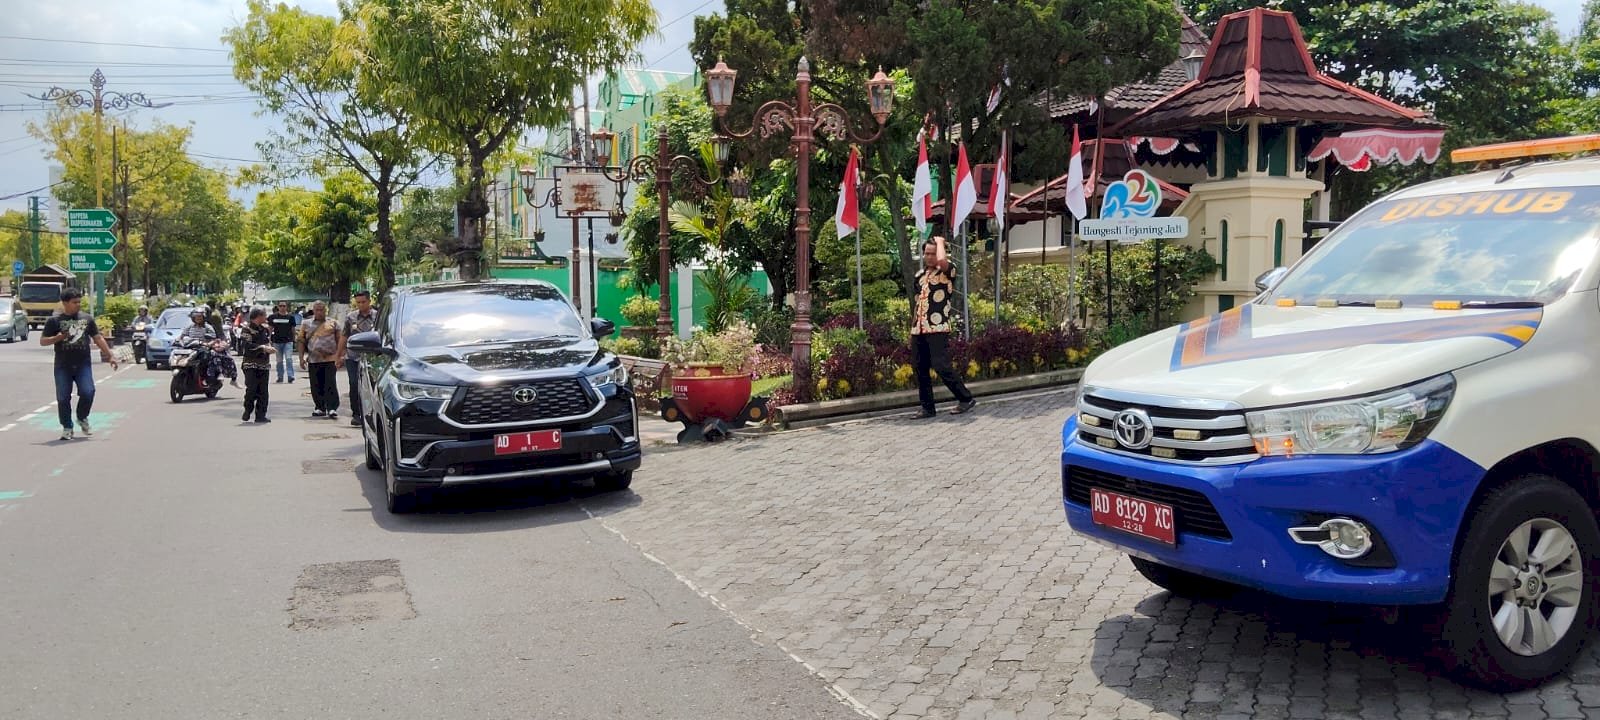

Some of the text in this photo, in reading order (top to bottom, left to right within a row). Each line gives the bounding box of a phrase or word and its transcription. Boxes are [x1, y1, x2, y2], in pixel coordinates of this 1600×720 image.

[1379, 190, 1575, 222] DISHUB
[1083, 224, 1183, 237] Hangesti Tejaning Jati
[497, 430, 560, 448] AD 1 C
[1094, 492, 1171, 530] AD 8129 XC
